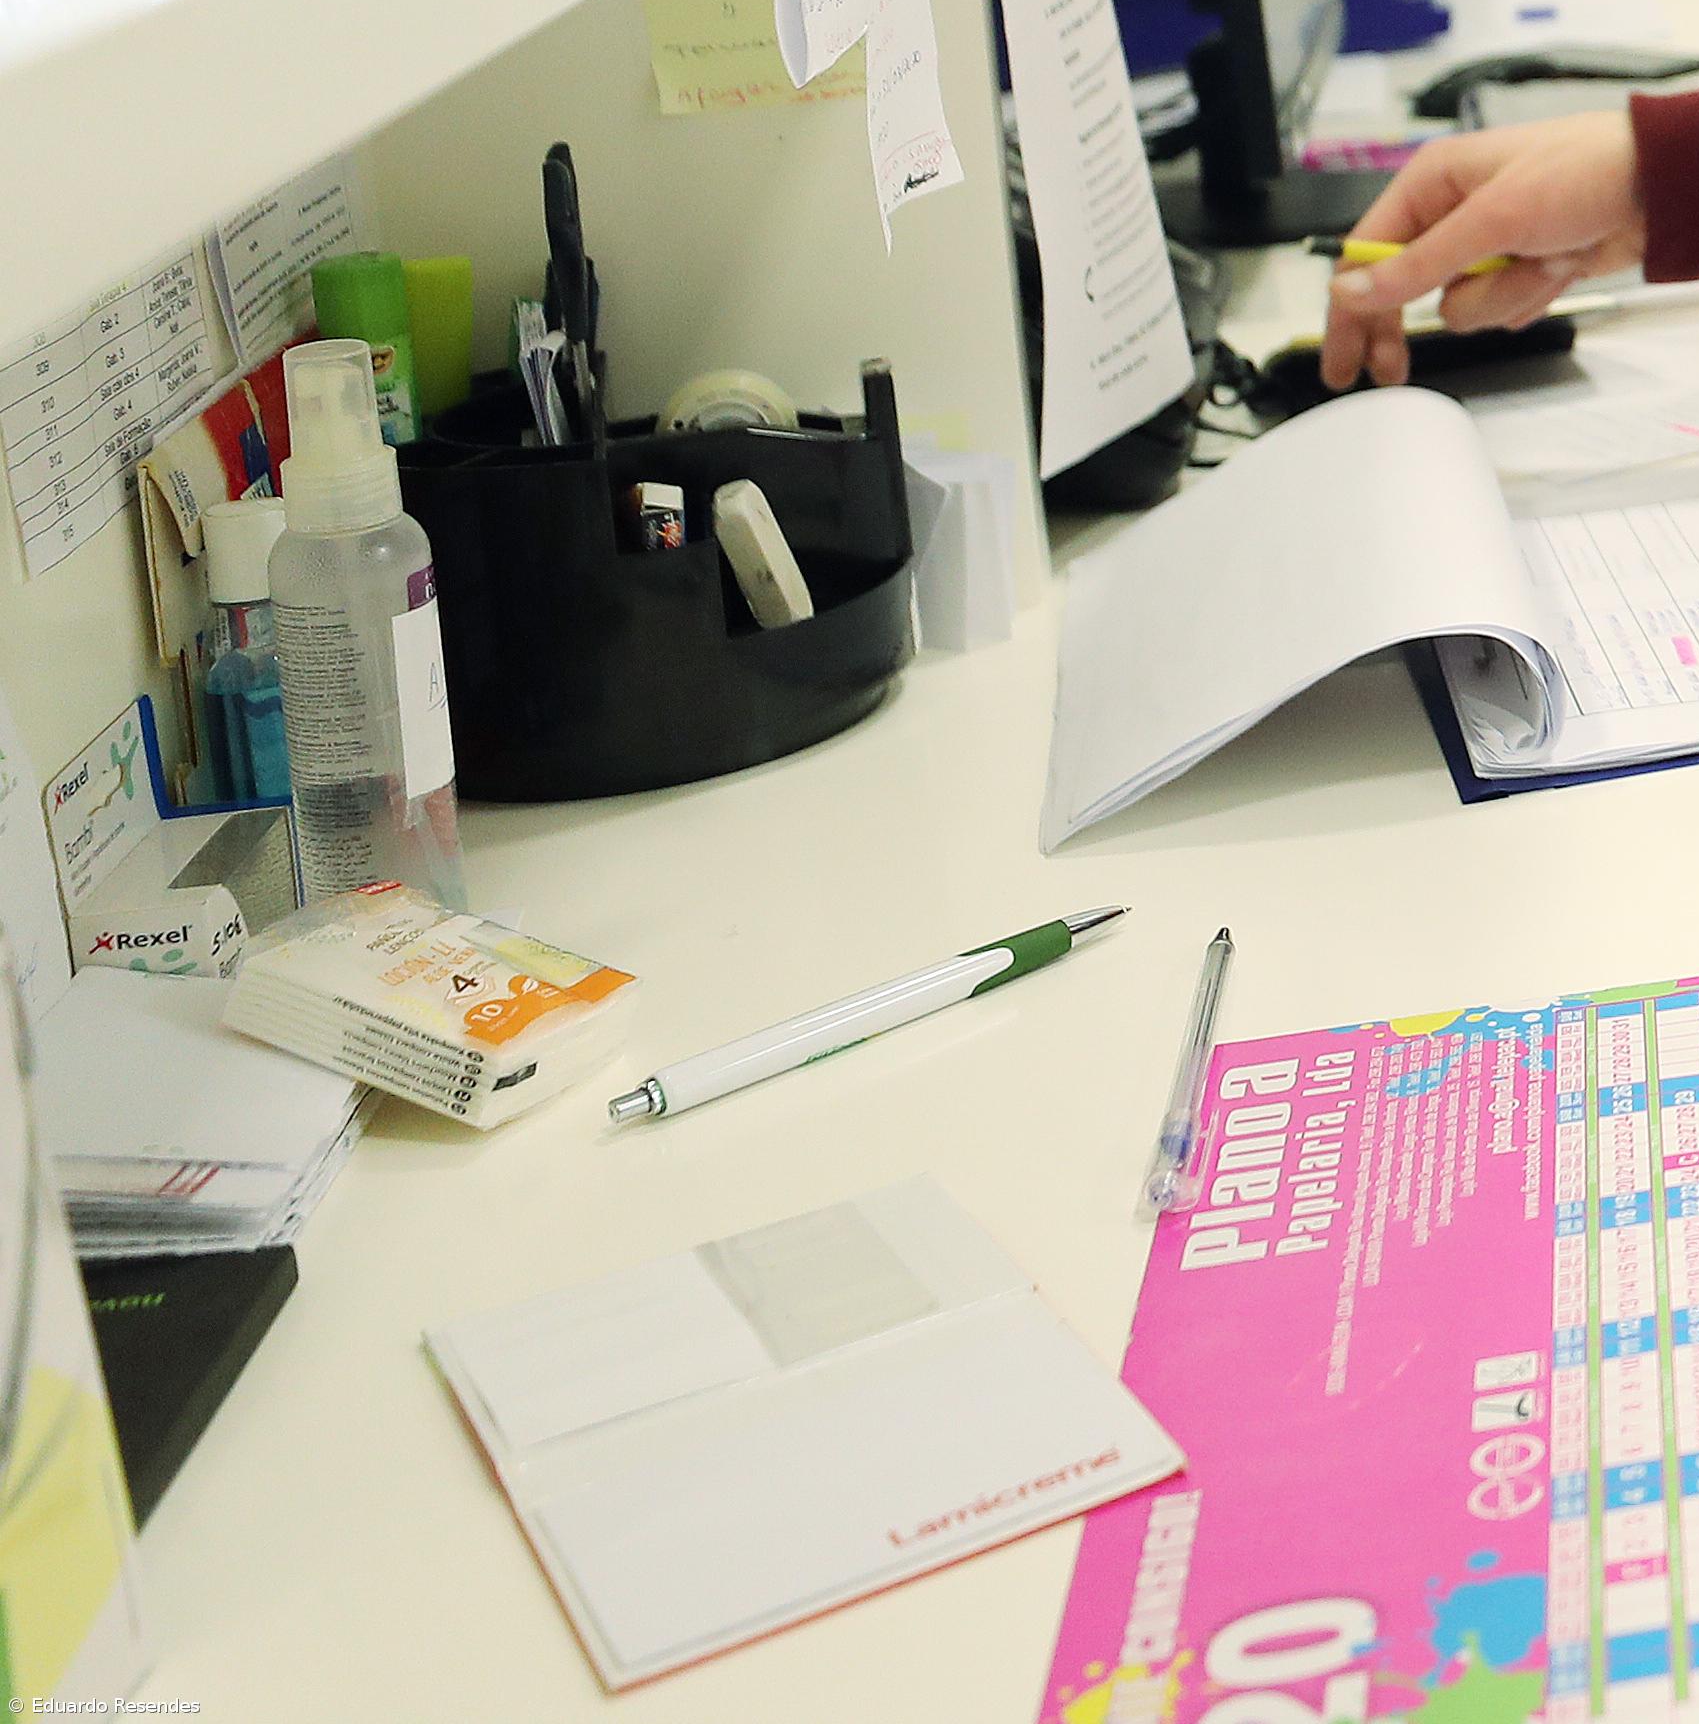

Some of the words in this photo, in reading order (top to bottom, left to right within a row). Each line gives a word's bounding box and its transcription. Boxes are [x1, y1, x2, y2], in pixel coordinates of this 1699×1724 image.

[62, 761, 89, 802] Rexel
[117, 926, 188, 950] Rexel
[452, 975, 478, 992] 4
[471, 1003, 504, 1022] 10
[1216, 1057, 1300, 1100] a
[1301, 1049, 1357, 1097] Lda
[1485, 1025, 1521, 1155] plano.a@mail.telepac.pt
[1178, 1101, 1293, 1271] Plano
[1274, 1099, 1356, 1255] Papelaria,
